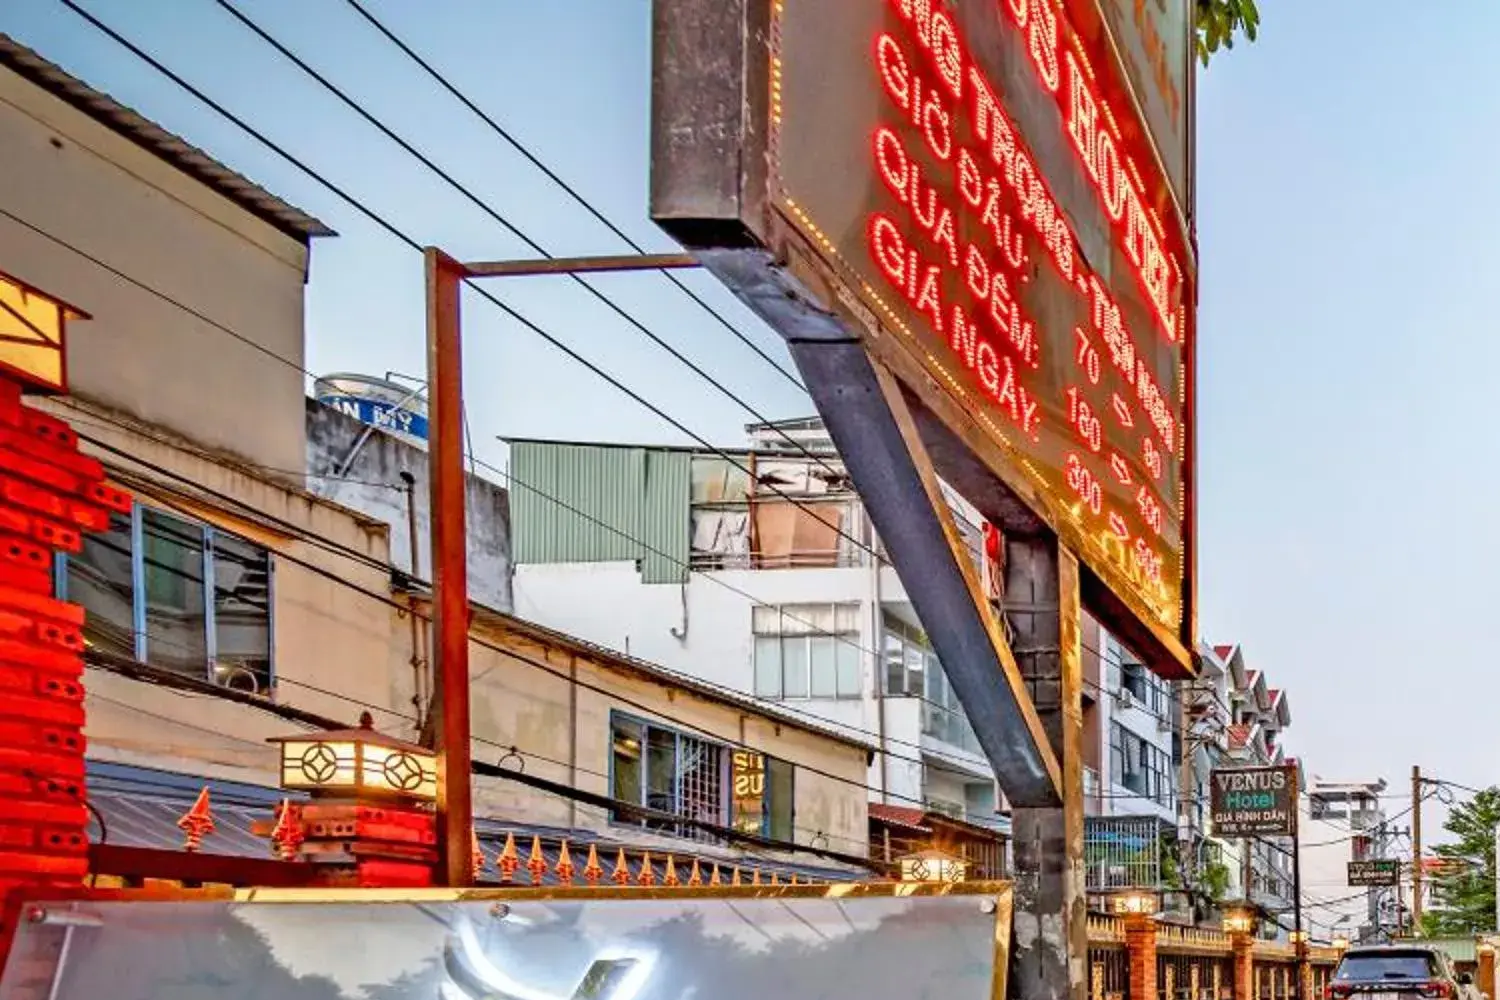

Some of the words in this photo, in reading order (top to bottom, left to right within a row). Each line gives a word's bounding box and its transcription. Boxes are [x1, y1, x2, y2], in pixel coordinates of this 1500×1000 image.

[877, 129, 958, 267] QUA
[1066, 50, 1176, 341] HOTEL
[1216, 771, 1285, 791] VENUS
